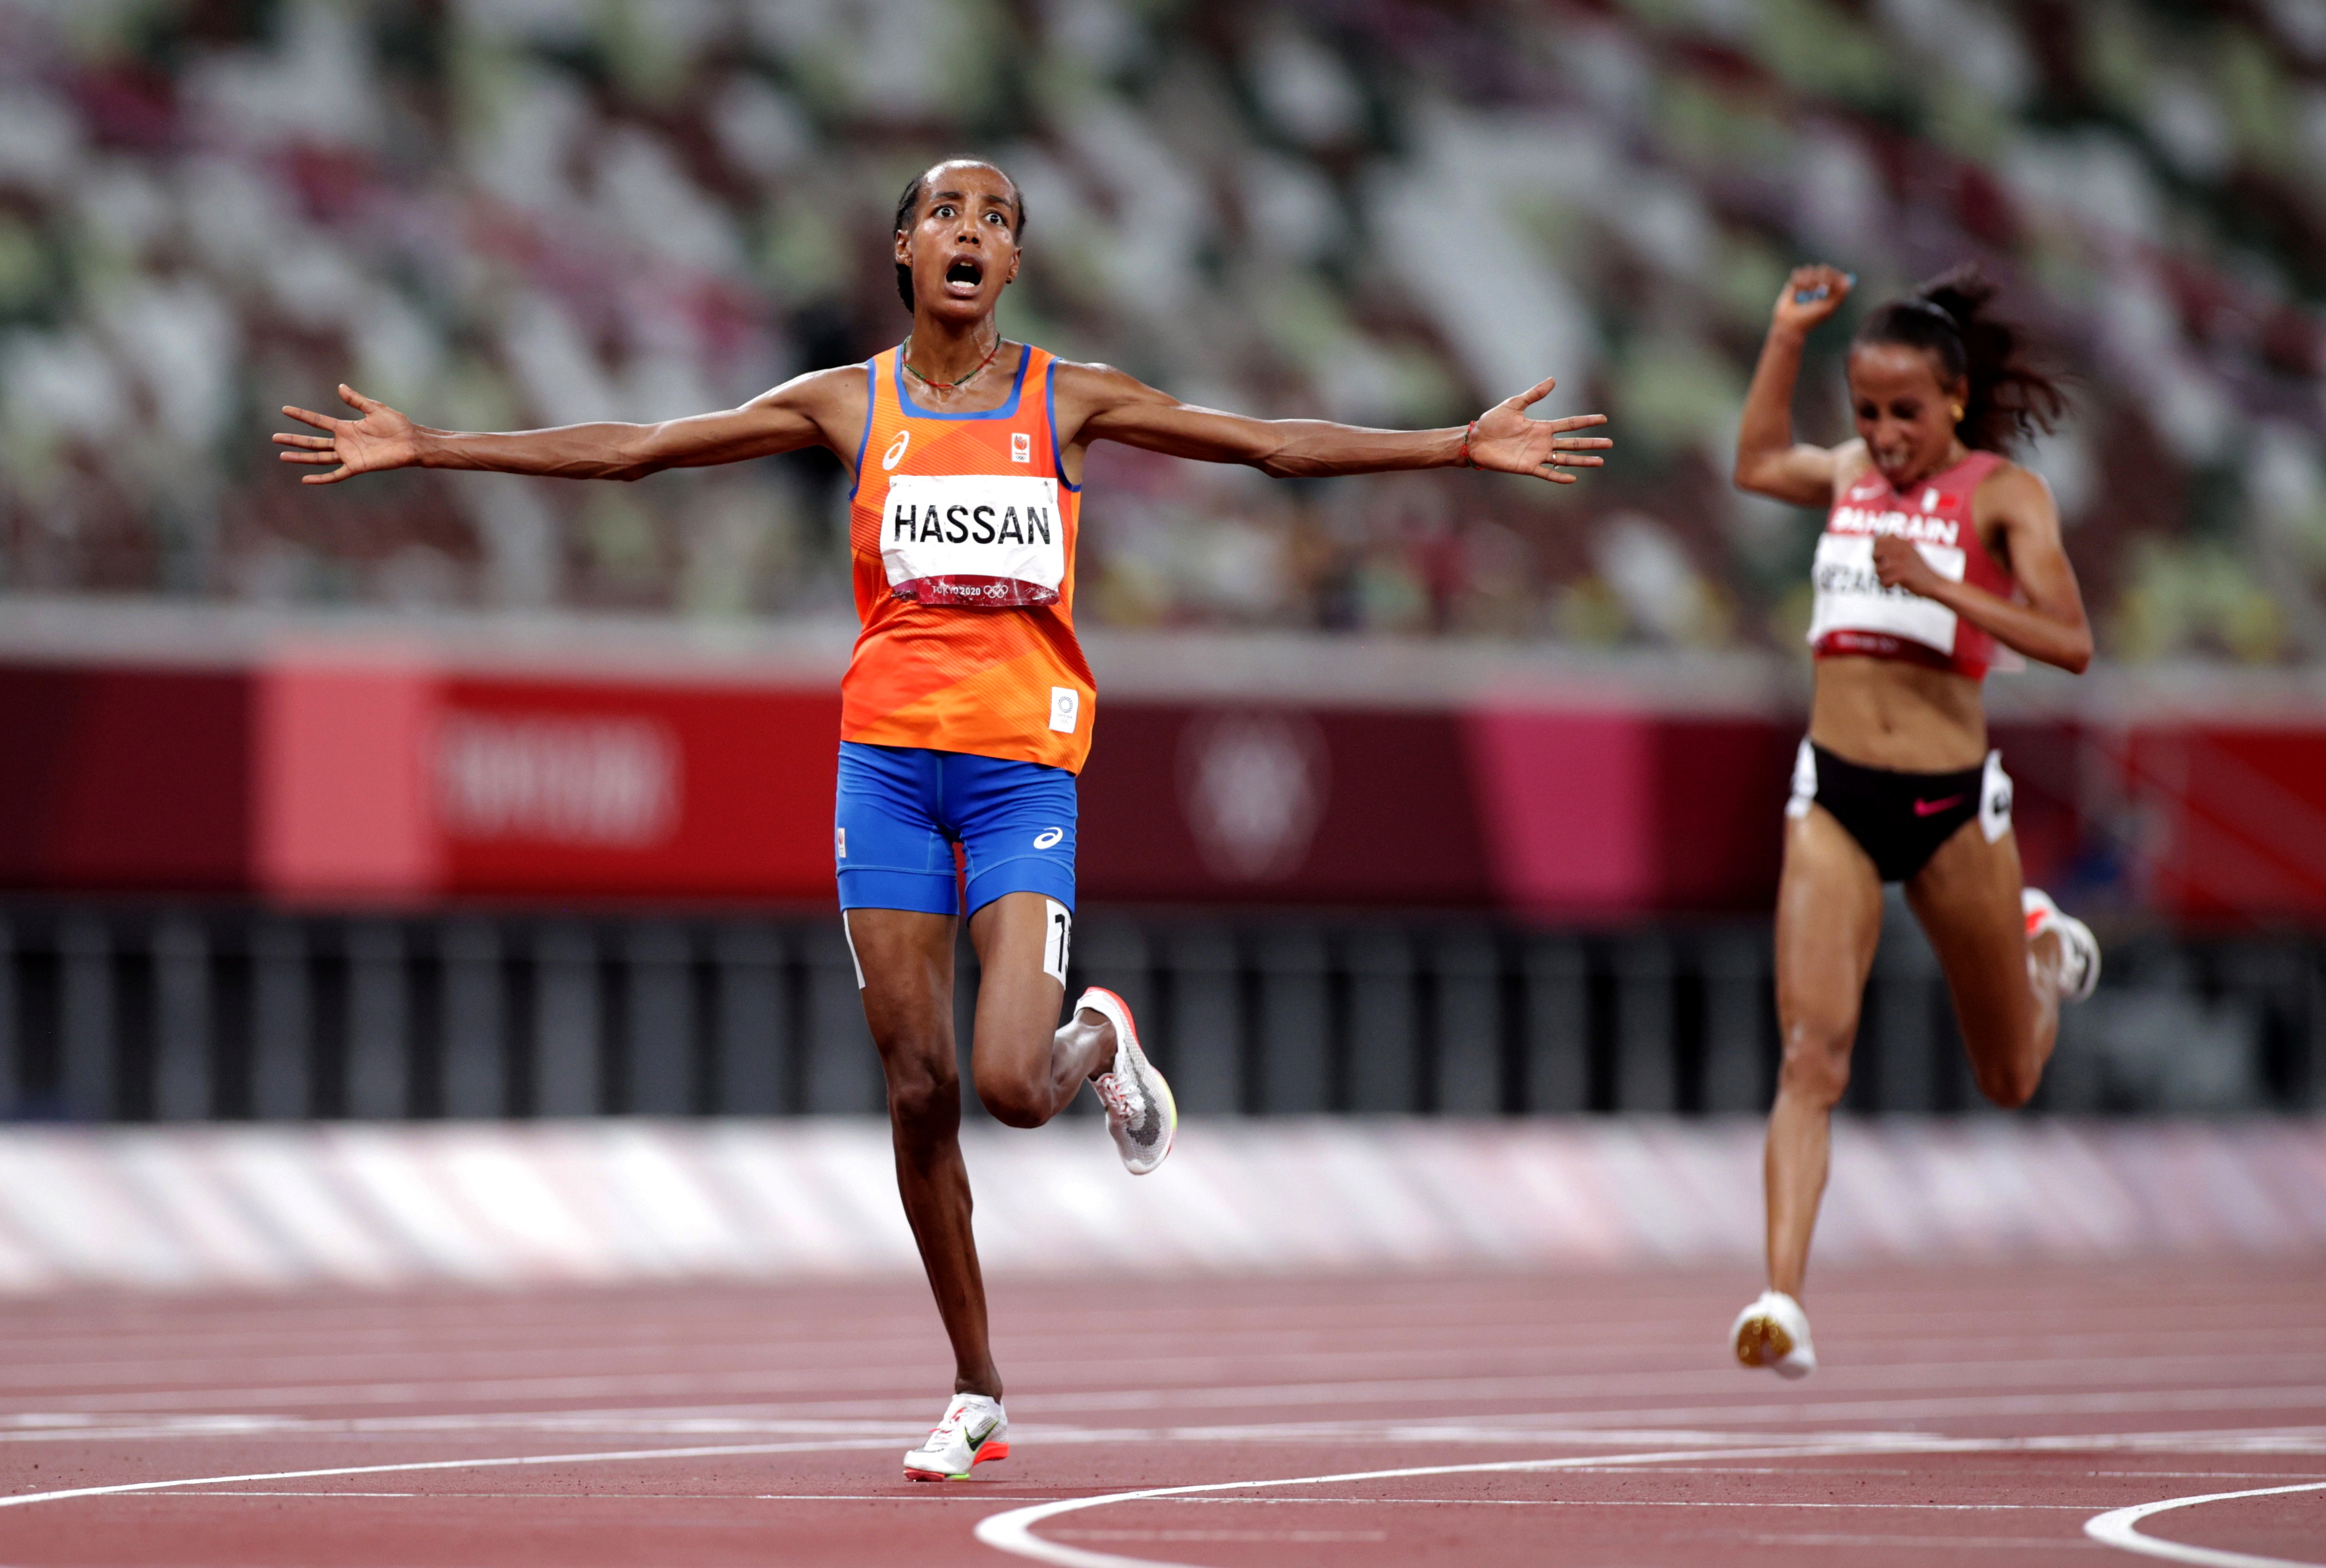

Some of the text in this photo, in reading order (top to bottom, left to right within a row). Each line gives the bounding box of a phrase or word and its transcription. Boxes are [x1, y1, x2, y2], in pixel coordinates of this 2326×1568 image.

[893, 504, 1051, 545] HASSAN
[1832, 507, 1959, 546] BAHRAIN
[932, 585, 981, 596] TOKYO 2020
